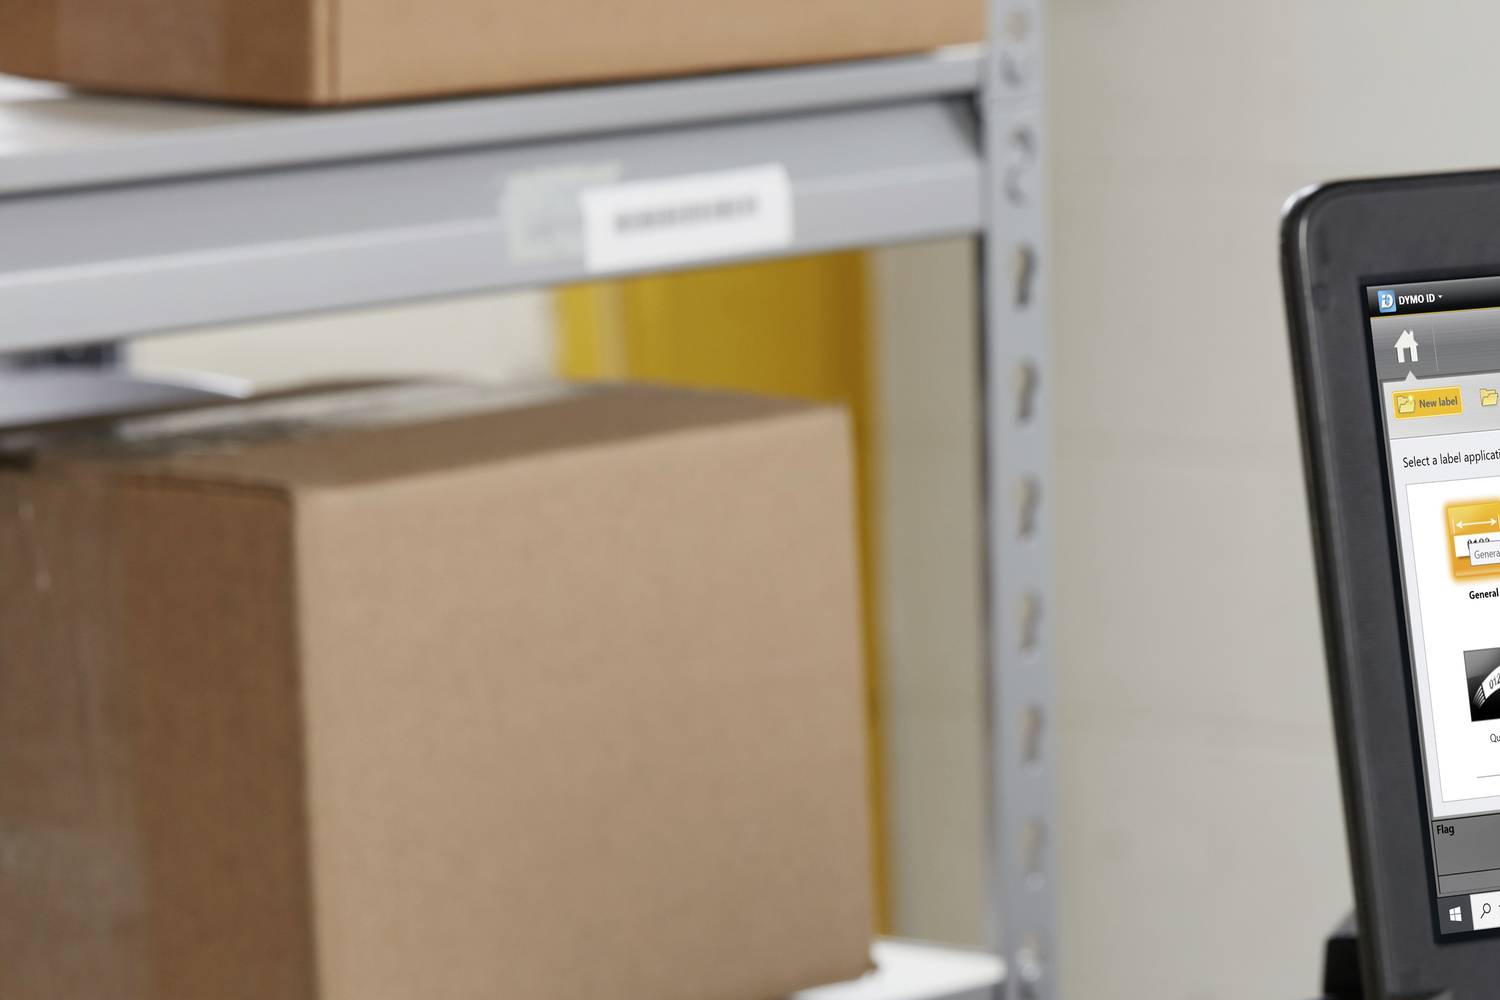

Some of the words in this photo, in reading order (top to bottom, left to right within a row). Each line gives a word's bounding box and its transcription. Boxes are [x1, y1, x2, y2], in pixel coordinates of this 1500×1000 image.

[1399, 295, 1424, 305] DYMO
[1426, 294, 1435, 303] ID
[1419, 399, 1437, 408] New
[1439, 397, 1458, 406] label
[1403, 456, 1430, 468] Select
[1432, 457, 1438, 465] a
[1440, 452, 1461, 464] label
[1469, 588, 1499, 600] General
[1437, 825, 1455, 836] Flag
